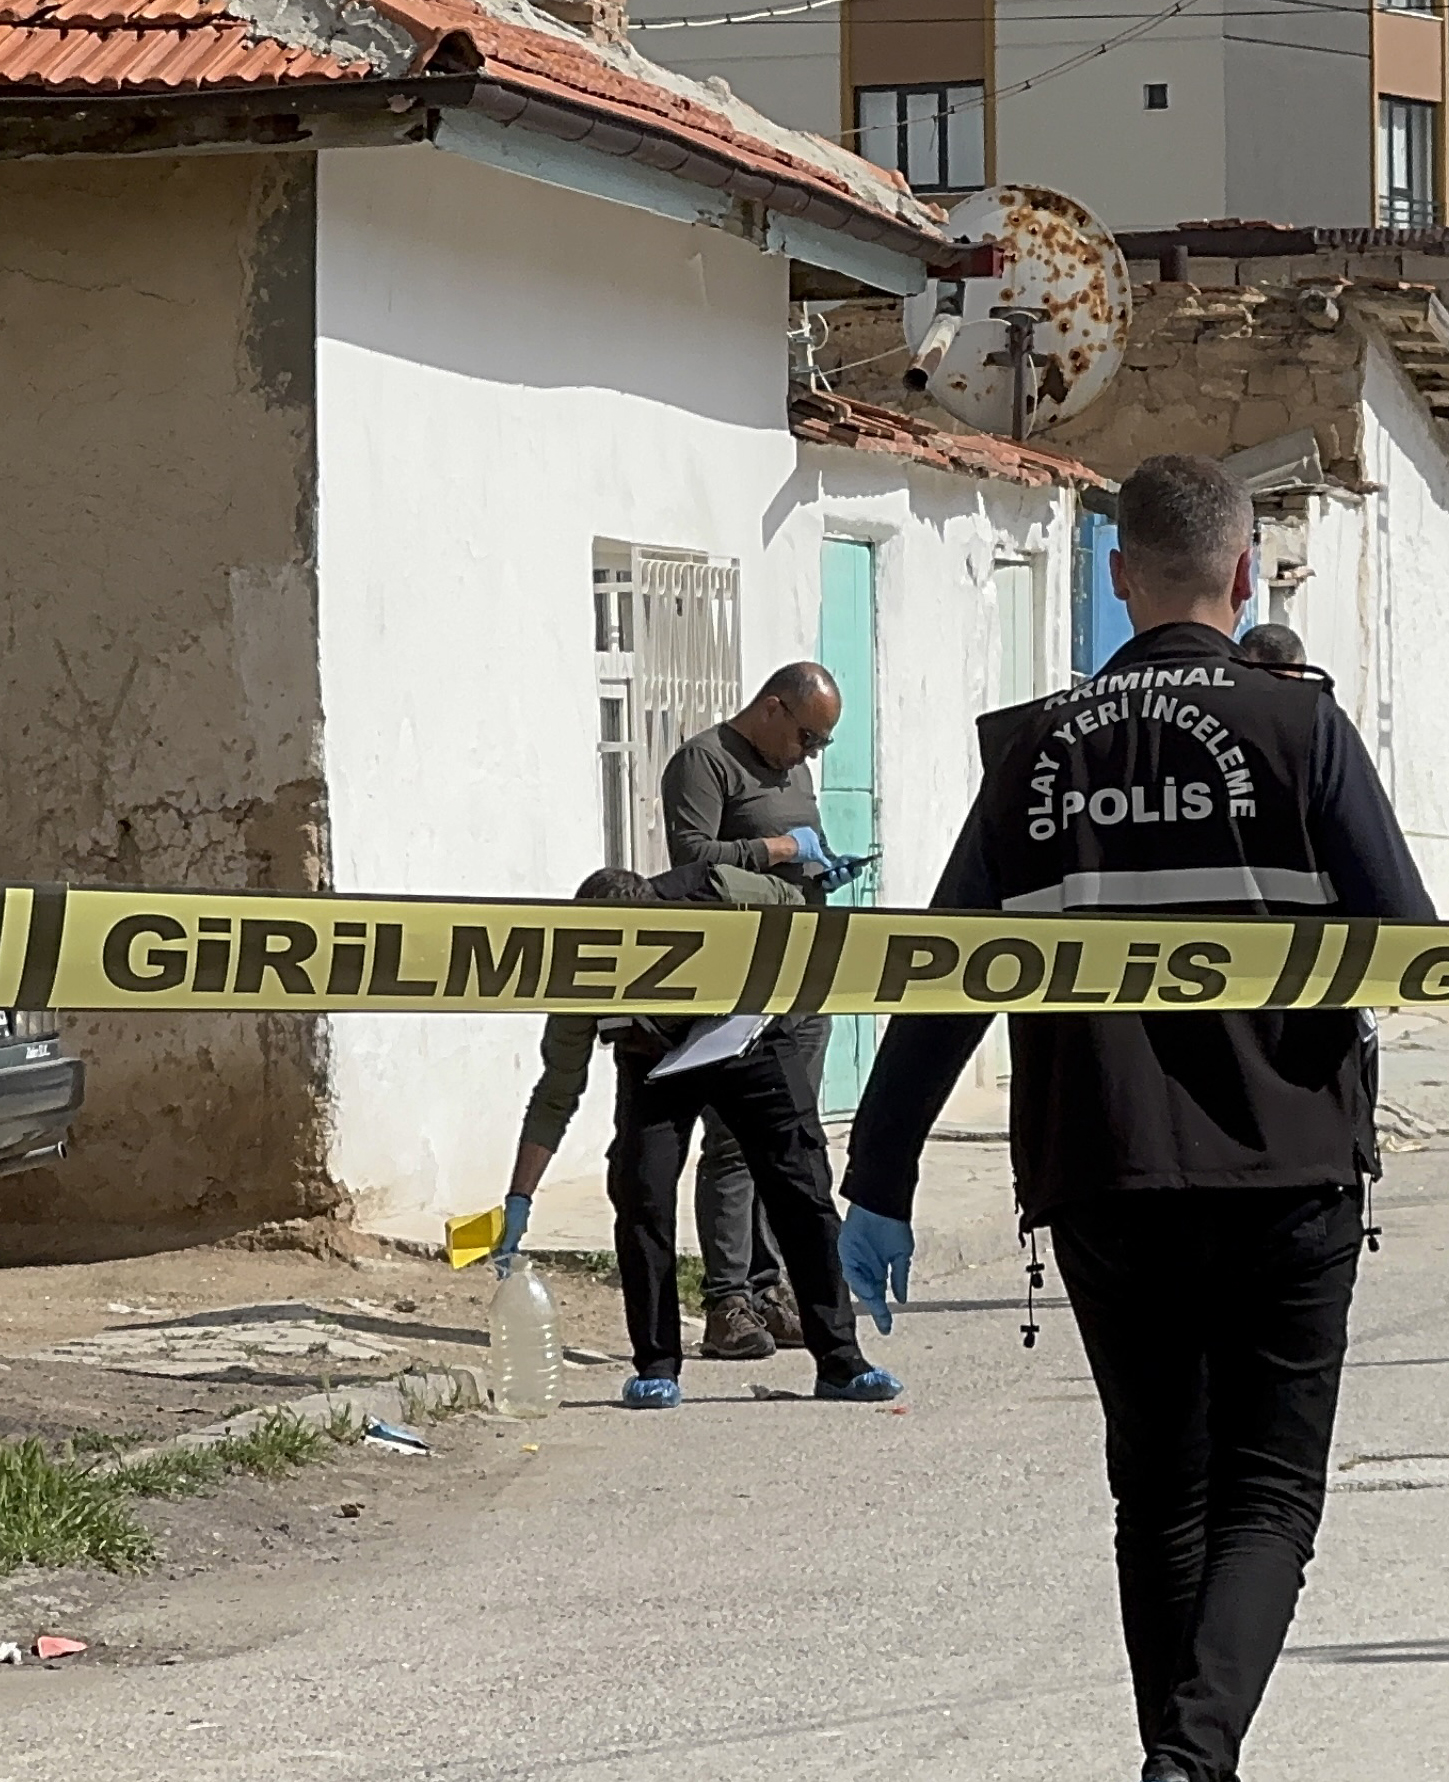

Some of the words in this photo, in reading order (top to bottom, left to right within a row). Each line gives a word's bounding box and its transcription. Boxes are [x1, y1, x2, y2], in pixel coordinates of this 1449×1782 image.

[1029, 751, 1060, 841] OLAY
[1053, 691, 1130, 746] YERİ
[1141, 689, 1256, 818] İNCELEME
[1062, 776, 1213, 830] POLİS
